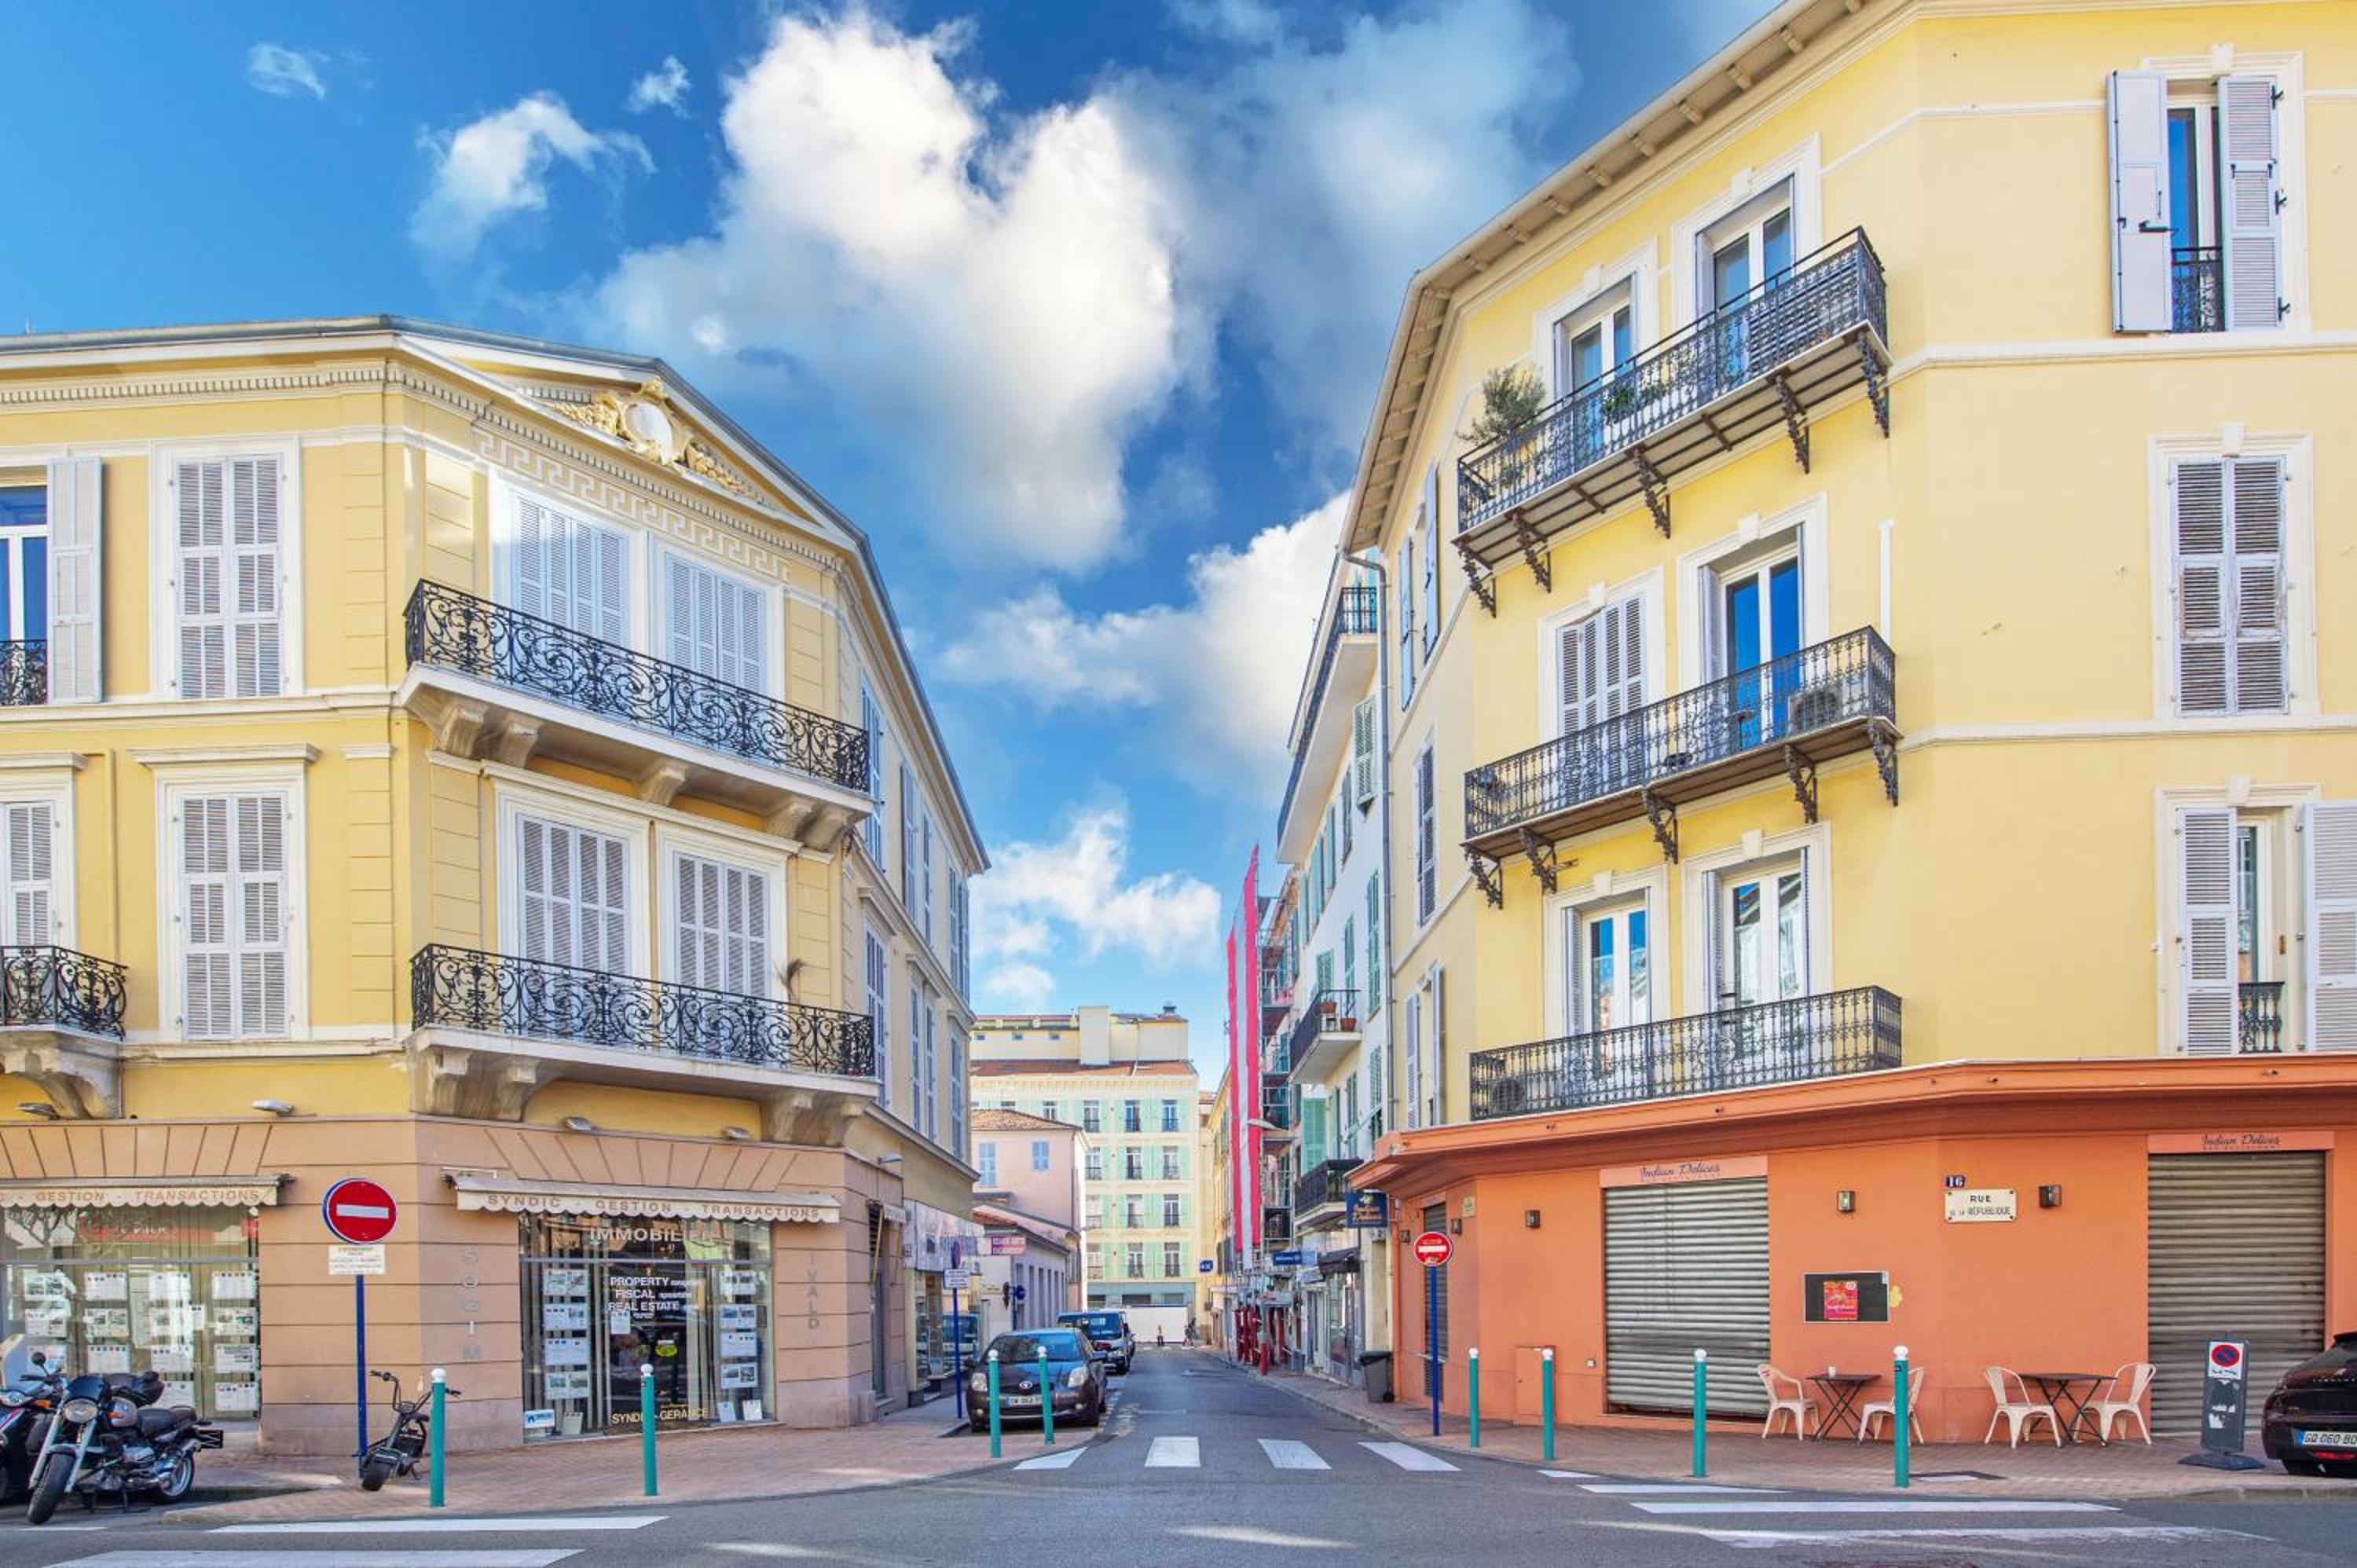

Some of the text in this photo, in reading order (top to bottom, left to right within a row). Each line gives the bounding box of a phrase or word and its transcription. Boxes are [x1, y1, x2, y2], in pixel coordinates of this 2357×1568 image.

[1948, 1176, 1963, 1187] 16
[36, 1189, 259, 1201] GESTION TRANSACTIONS
[487, 1194, 819, 1218] SYNDIC GESTION TRANSACTIONS
[610, 1277, 669, 1287] PROPERTY
[615, 1289, 656, 1299] FISCAL
[607, 1302, 639, 1313] REAL
[640, 1301, 680, 1311] ESTATE
[612, 1407, 709, 1424] SYNDI GERANCE
